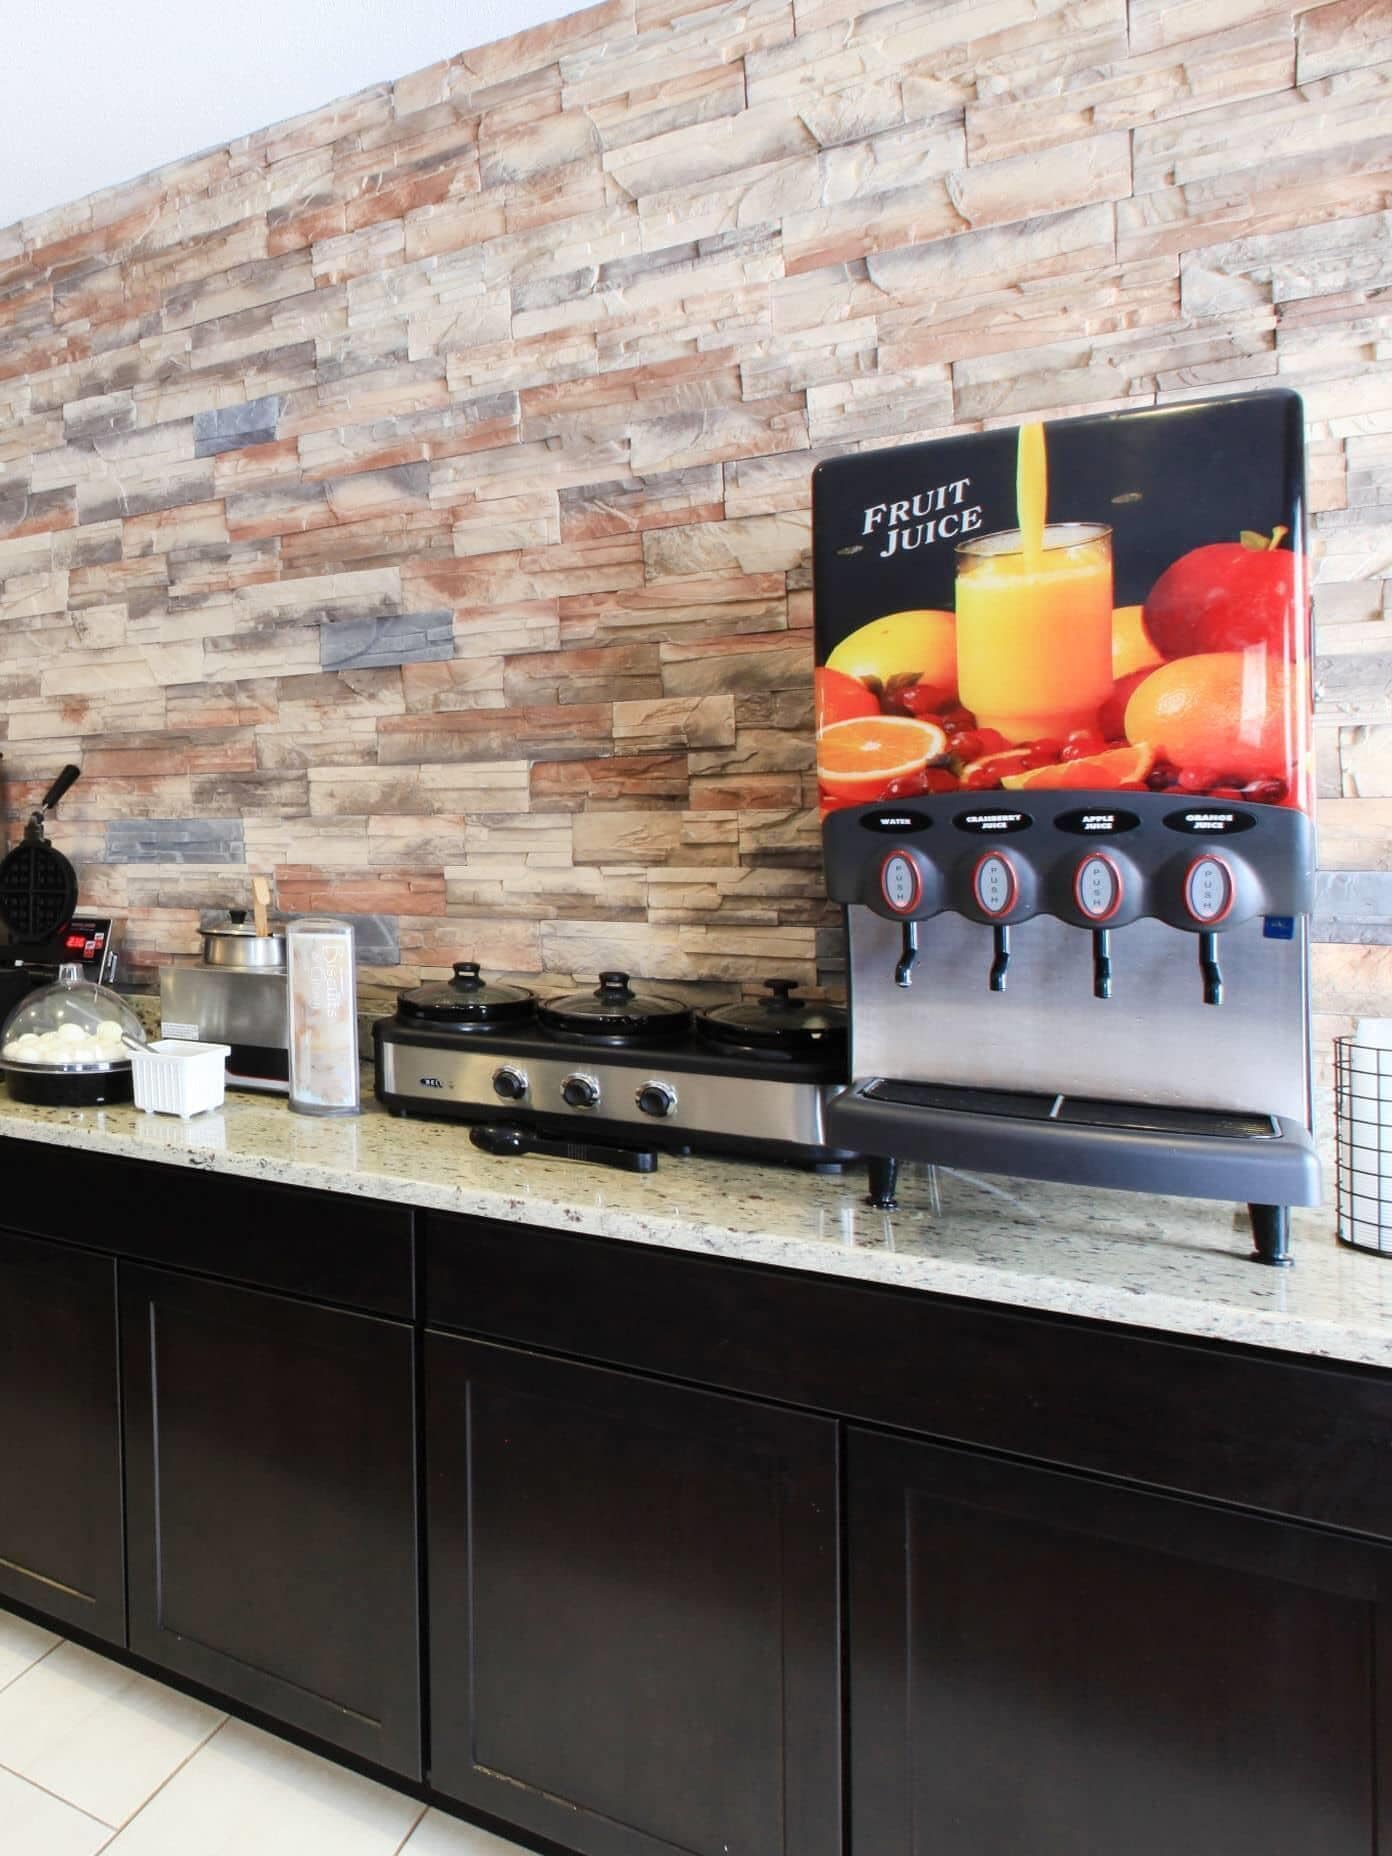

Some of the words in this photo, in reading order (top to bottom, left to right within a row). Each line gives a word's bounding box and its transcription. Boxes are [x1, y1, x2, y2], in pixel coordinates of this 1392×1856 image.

[861, 477, 971, 536] FRUIT
[879, 506, 983, 558] JUICE
[966, 814, 1022, 823] CRANBERRY
[982, 821, 1007, 829] JUICE
[1082, 815, 1115, 823] APPLE
[1084, 822, 1113, 830] JUICE
[1185, 814, 1234, 822] ORANGE
[1193, 822, 1224, 830] JUICE
[895, 864, 905, 900] PUSH
[990, 867, 1000, 903] PUSH
[1092, 868, 1102, 907] PUSH
[1203, 870, 1213, 909] PUSH
